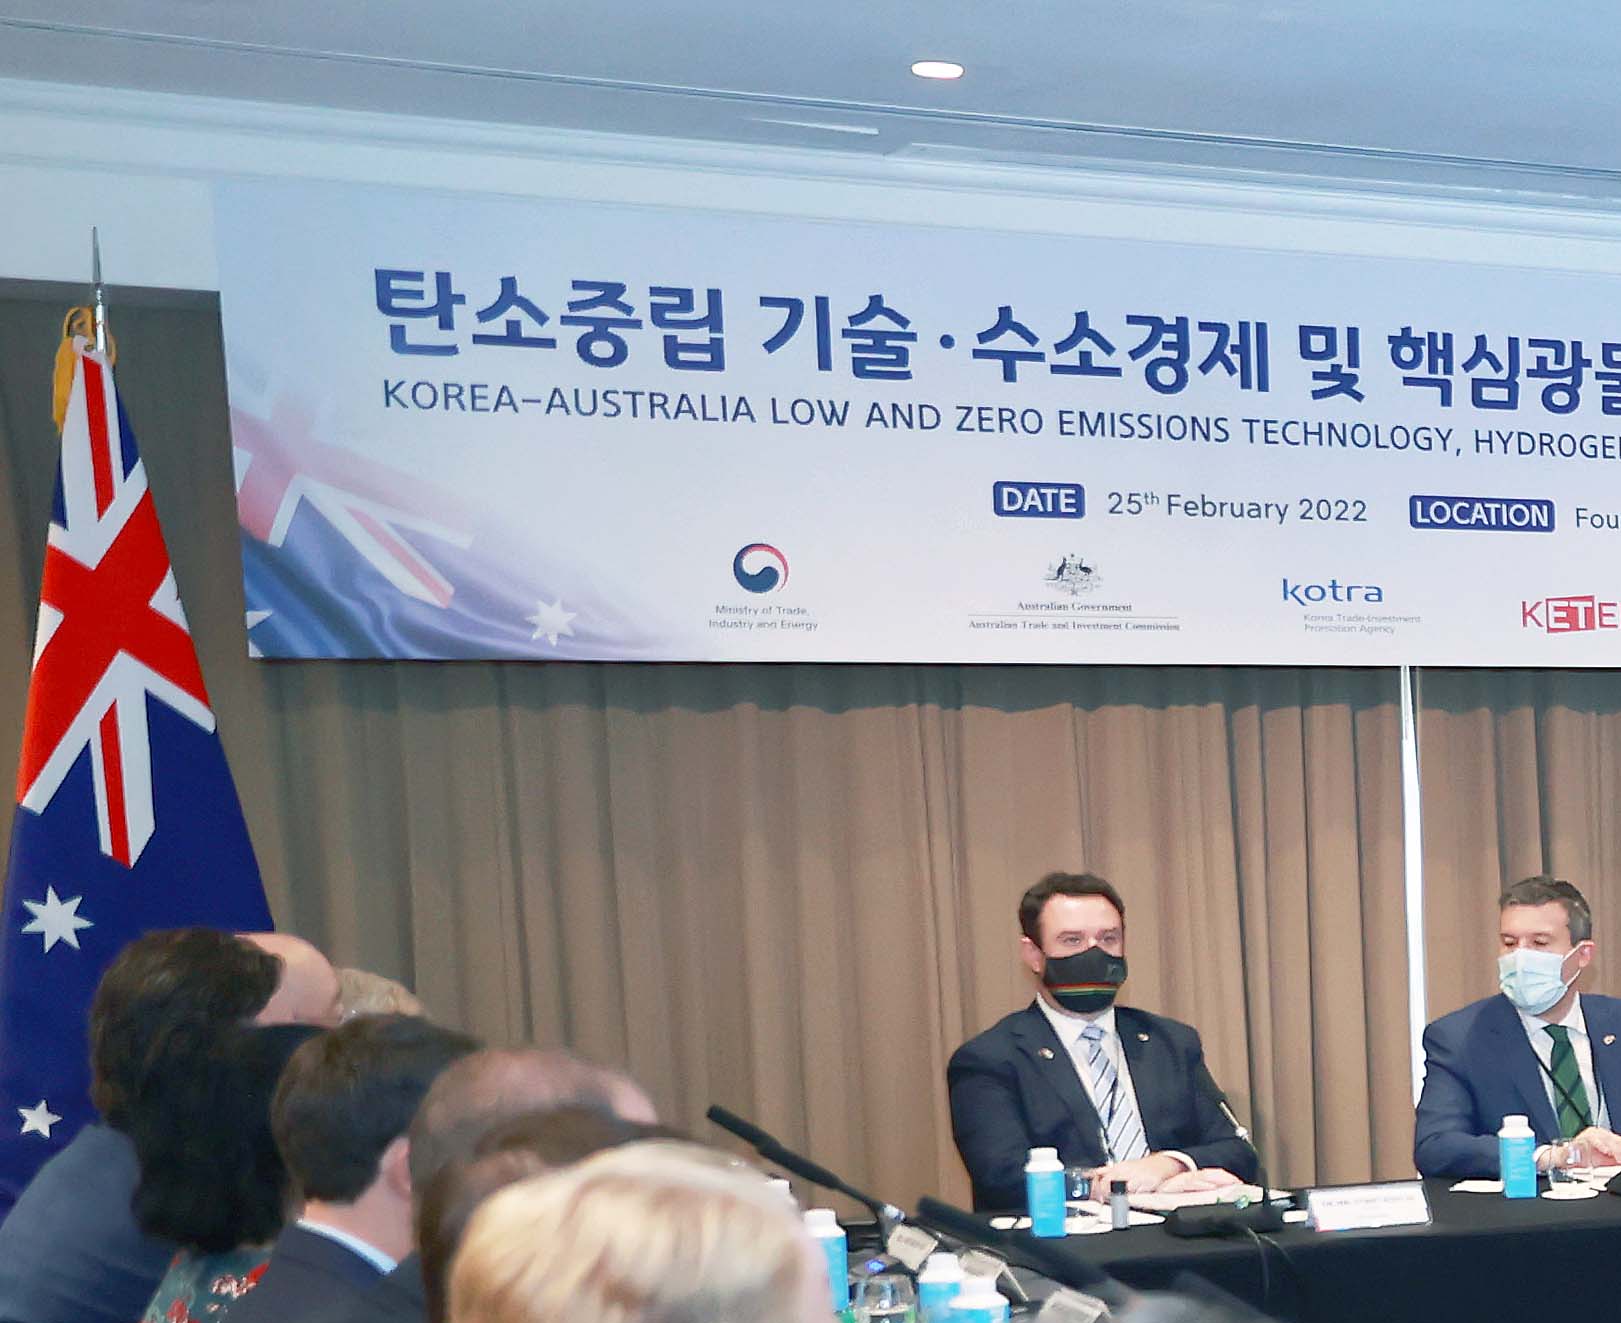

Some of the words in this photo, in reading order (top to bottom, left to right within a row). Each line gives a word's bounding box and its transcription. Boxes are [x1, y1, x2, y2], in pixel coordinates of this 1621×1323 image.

[373, 267, 726, 373] 탄소중립
[1298, 324, 1366, 403] 및
[770, 397, 850, 427] LOW
[865, 401, 942, 430] AND
[955, 405, 1044, 435] ZERO
[1058, 409, 1230, 443] EMISSIONS
[1241, 418, 1461, 457] TECHNOLOGY,
[1001, 486, 1077, 513] DATE
[1167, 494, 1289, 525] February
[1299, 498, 1367, 522] 2022
[1415, 500, 1549, 528] LOCATION
[1282, 578, 1384, 606] kotra
[715, 605, 759, 616] Ministry
[761, 605, 773, 615] of
[1016, 602, 1069, 612] Australian
[1071, 602, 1133, 613] Government
[708, 620, 754, 631] Industry
[757, 620, 777, 629] and
[781, 620, 818, 632] Energy
[968, 620, 1018, 630] Australian
[1021, 620, 1048, 630] Trade
[1052, 621, 1069, 630] and
[1072, 621, 1122, 631] Investment
[1359, 624, 1395, 634] Agency
